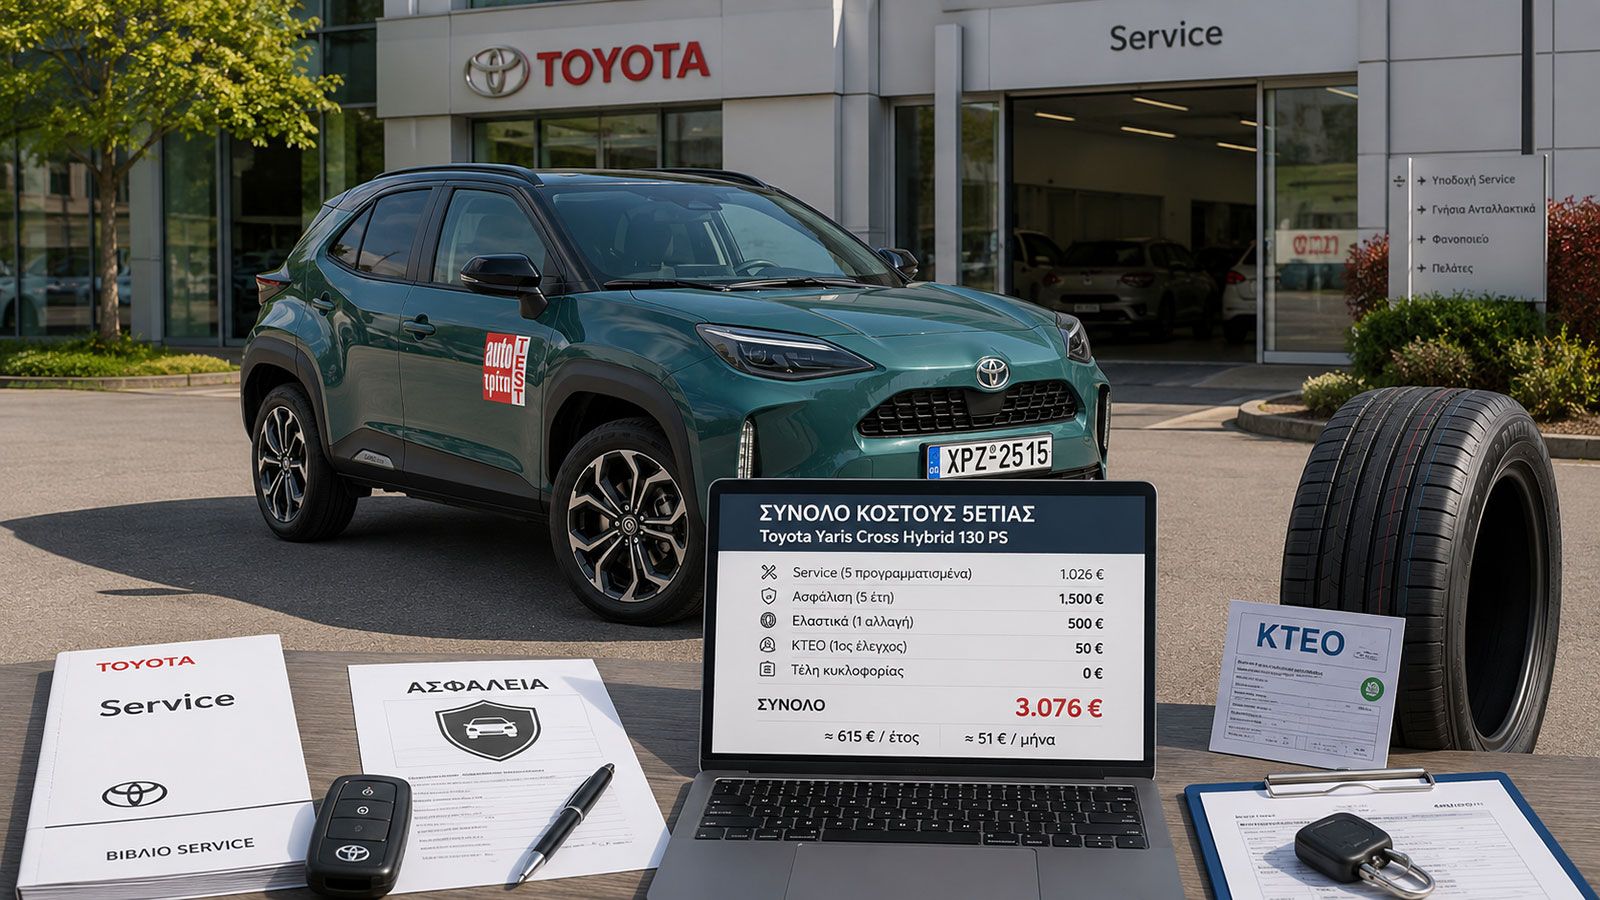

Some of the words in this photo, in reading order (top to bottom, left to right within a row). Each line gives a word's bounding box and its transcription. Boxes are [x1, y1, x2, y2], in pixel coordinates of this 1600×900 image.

[1110, 20, 1223, 52] Service
[536, 41, 711, 88] TOYOTA
[1431, 174, 1477, 187] Υποδοχή
[1478, 174, 1516, 185] Service
[1432, 204, 1466, 216] Γνήσια
[1467, 203, 1536, 214] Ανταλλακτικά
[1432, 262, 1474, 275] Πελάτες
[513, 338, 529, 404] TEST
[759, 504, 851, 522] ΣΥΝΟΛΟ
[856, 504, 956, 523] ΚΟΣΤΟΥΣ
[962, 505, 1035, 523] 5ΕΤΙΑΣ
[759, 529, 812, 546] Toyota
[815, 529, 853, 544] Yaris
[856, 529, 900, 544] Cross
[903, 529, 955, 547] Hybrid
[958, 530, 985, 544] 130
[988, 530, 1009, 544] PS
[792, 566, 838, 579] Service
[840, 566, 853, 580] (5
[855, 567, 972, 582] προγραμματισμένα)
[1060, 568, 1093, 580] 1.026
[1095, 568, 1105, 581] €
[792, 590, 853, 605] Ασφάλιση
[855, 591, 868, 605] (5
[870, 591, 895, 605] έτη)
[1095, 593, 1104, 605] €
[792, 614, 849, 627] Ελαστικά
[852, 615, 862, 629] (1
[864, 615, 914, 630] αλλαγή)
[1068, 617, 1093, 630] 500
[1095, 617, 1104, 630] €
[791, 639, 826, 652] ΚΤΕΟ
[829, 639, 853, 653] (1ος
[855, 639, 907, 655] έλεγχος)
[1256, 622, 1345, 657] ΚΤΕΟ
[1075, 642, 1092, 655] 50
[1094, 642, 1104, 655] €
[96, 655, 196, 673] TOYOTA
[790, 663, 820, 678] Τέλη
[823, 664, 904, 679] κυκλοφορίας
[1082, 667, 1092, 680] 0
[1093, 667, 1104, 680] €
[406, 678, 550, 694] ΑΣΦΑΛΕΙΑ
[99, 693, 235, 717] Service
[757, 698, 826, 712] ΣΥΝΟΛΟ
[1015, 697, 1082, 718] 3.076
[1087, 698, 1103, 718] €
[837, 729, 862, 743] 615
[865, 730, 876, 743] €
[888, 730, 920, 746] έτος
[978, 732, 993, 745] 51
[997, 732, 1007, 745] €
[1020, 732, 1056, 749] μήνα
[106, 846, 172, 861] ΒΙΒΛΙΟ
[177, 837, 255, 855] SERVICE
